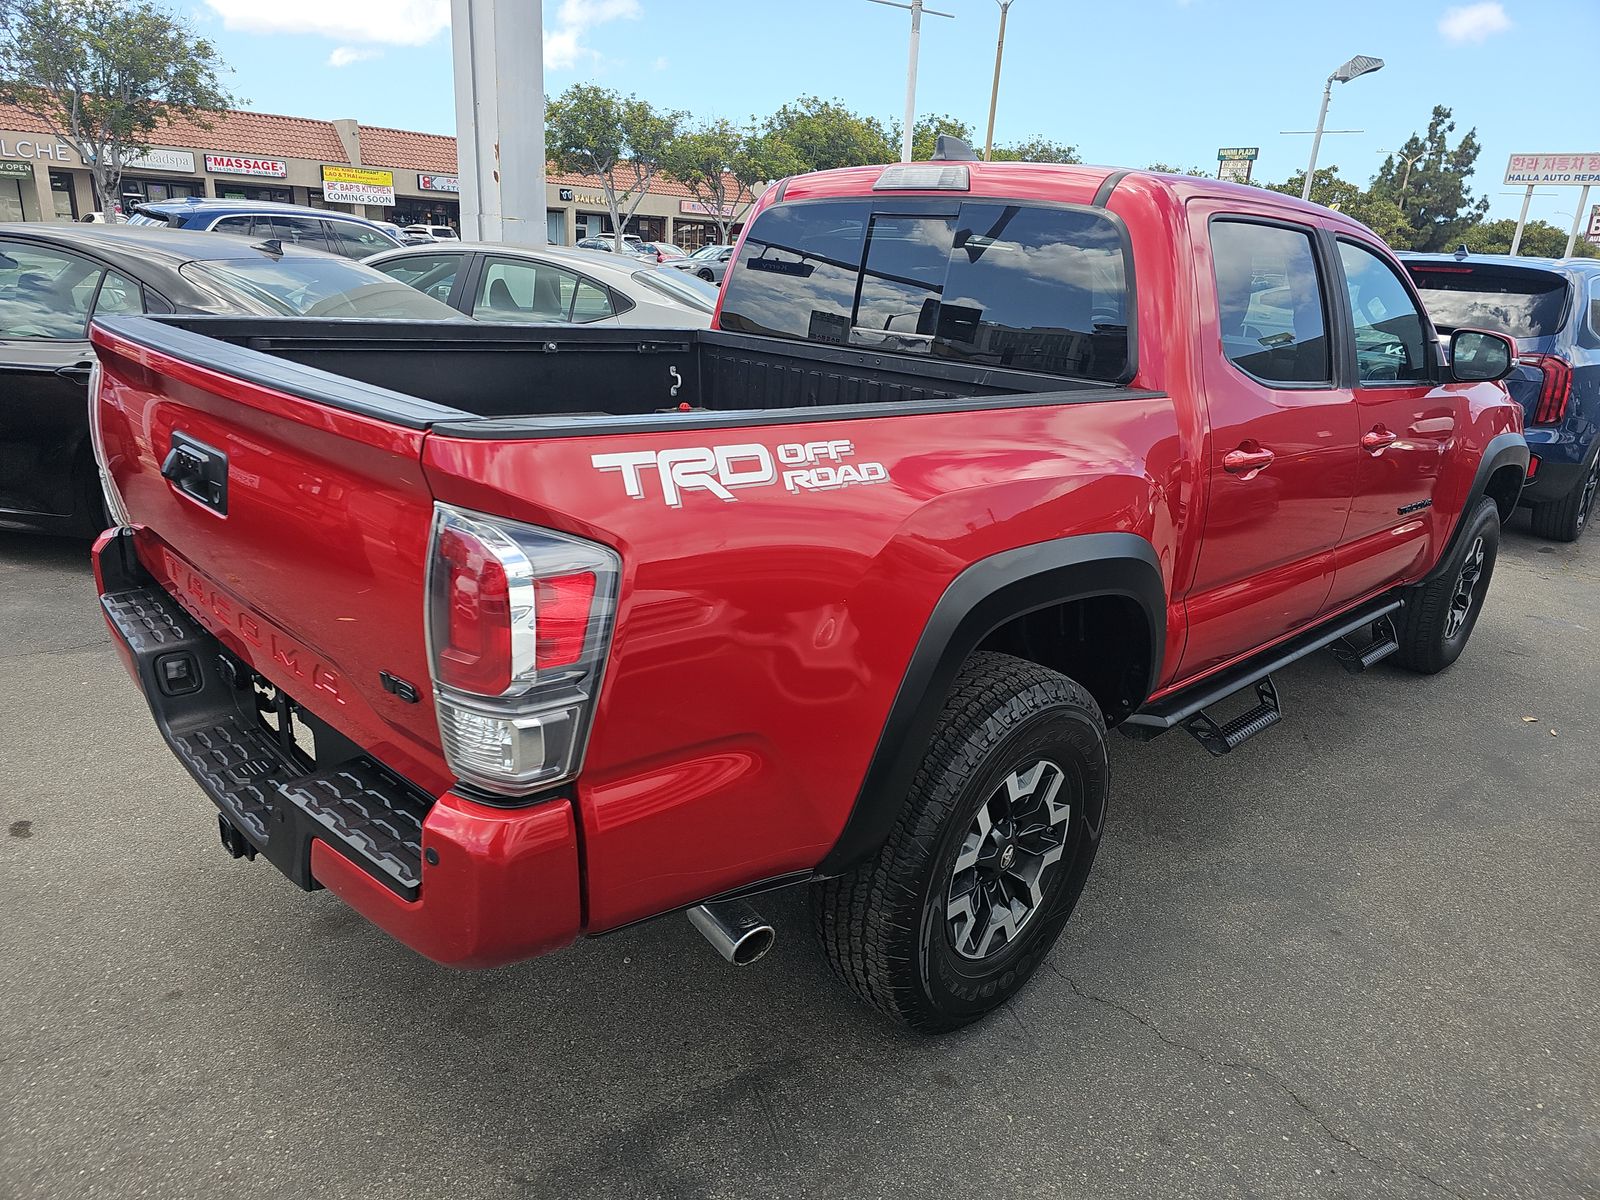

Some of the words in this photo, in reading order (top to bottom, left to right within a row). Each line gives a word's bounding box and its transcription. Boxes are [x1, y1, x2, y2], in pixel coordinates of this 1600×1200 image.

[6, 163, 31, 171] OPEN
[213, 157, 279, 171] MASSAGE
[1542, 157, 1585, 171] 자동차
[328, 192, 365, 202] COMING
[367, 195, 391, 203] SOON
[340, 183, 360, 192] BAP'S
[361, 185, 392, 194] KITCHEN
[776, 440, 854, 466] OFF
[591, 443, 777, 508] TRD
[782, 462, 890, 494] ROAD
[164, 554, 346, 705] TACOMA
[379, 670, 420, 704] V6
